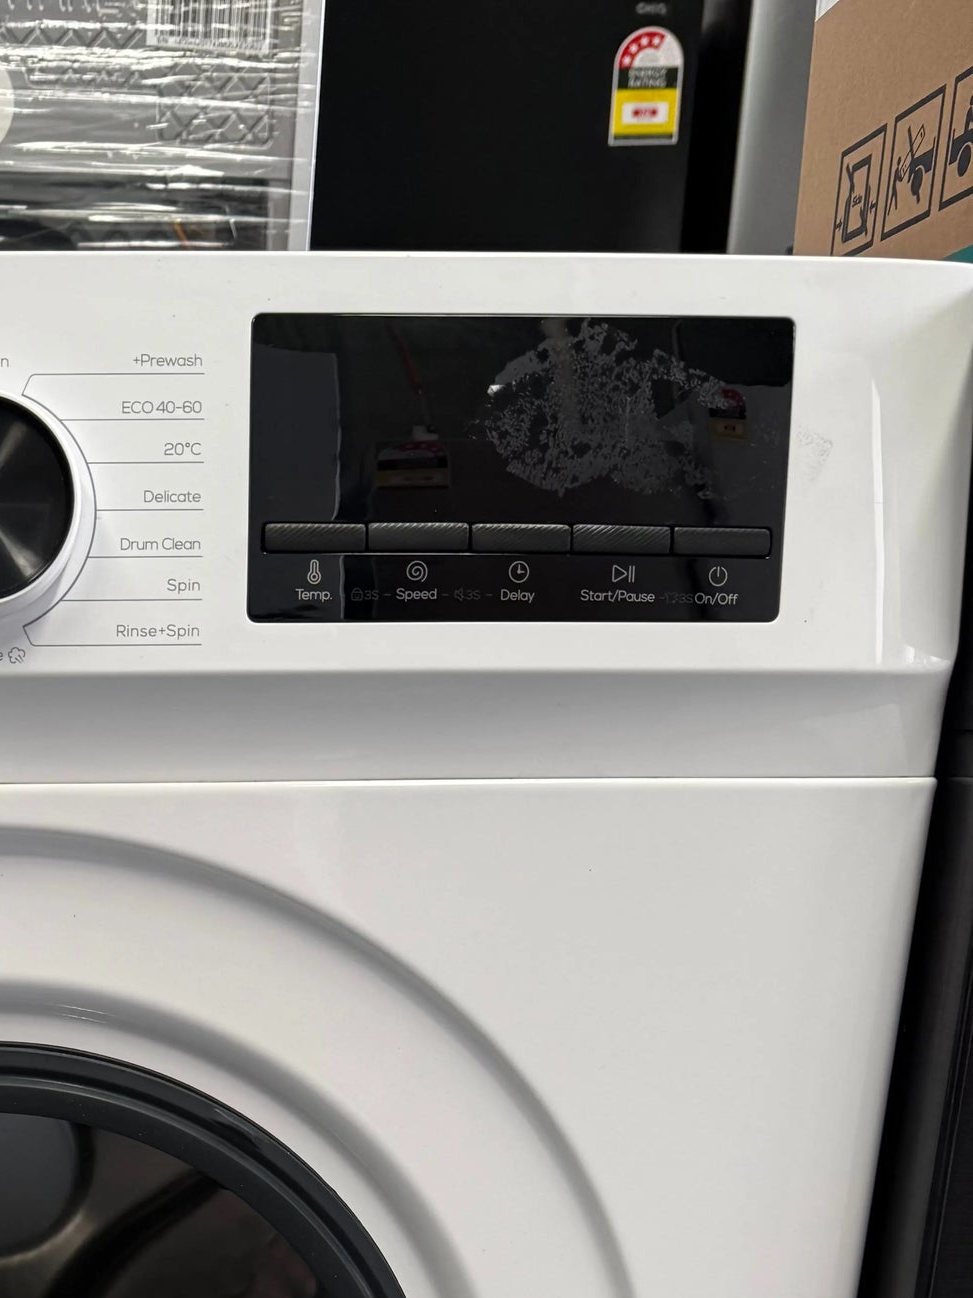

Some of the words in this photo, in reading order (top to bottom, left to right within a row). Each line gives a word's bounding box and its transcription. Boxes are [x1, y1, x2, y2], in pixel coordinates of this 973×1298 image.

[133, 353, 203, 367] +Prewash
[122, 401, 154, 414] ECO
[156, 400, 203, 414] 40-60
[163, 442, 202, 456] 20°C
[143, 490, 202, 503] Delicate
[120, 538, 159, 551] Drum
[161, 538, 201, 550] Clean
[167, 579, 201, 595] Spin
[295, 589, 333, 603] Temp.
[396, 588, 437, 602] Speed
[500, 588, 535, 605] Delay
[580, 589, 655, 603] Start/Pause
[695, 592, 739, 606] On/Off
[116, 624, 201, 641] Rinse+Spin
